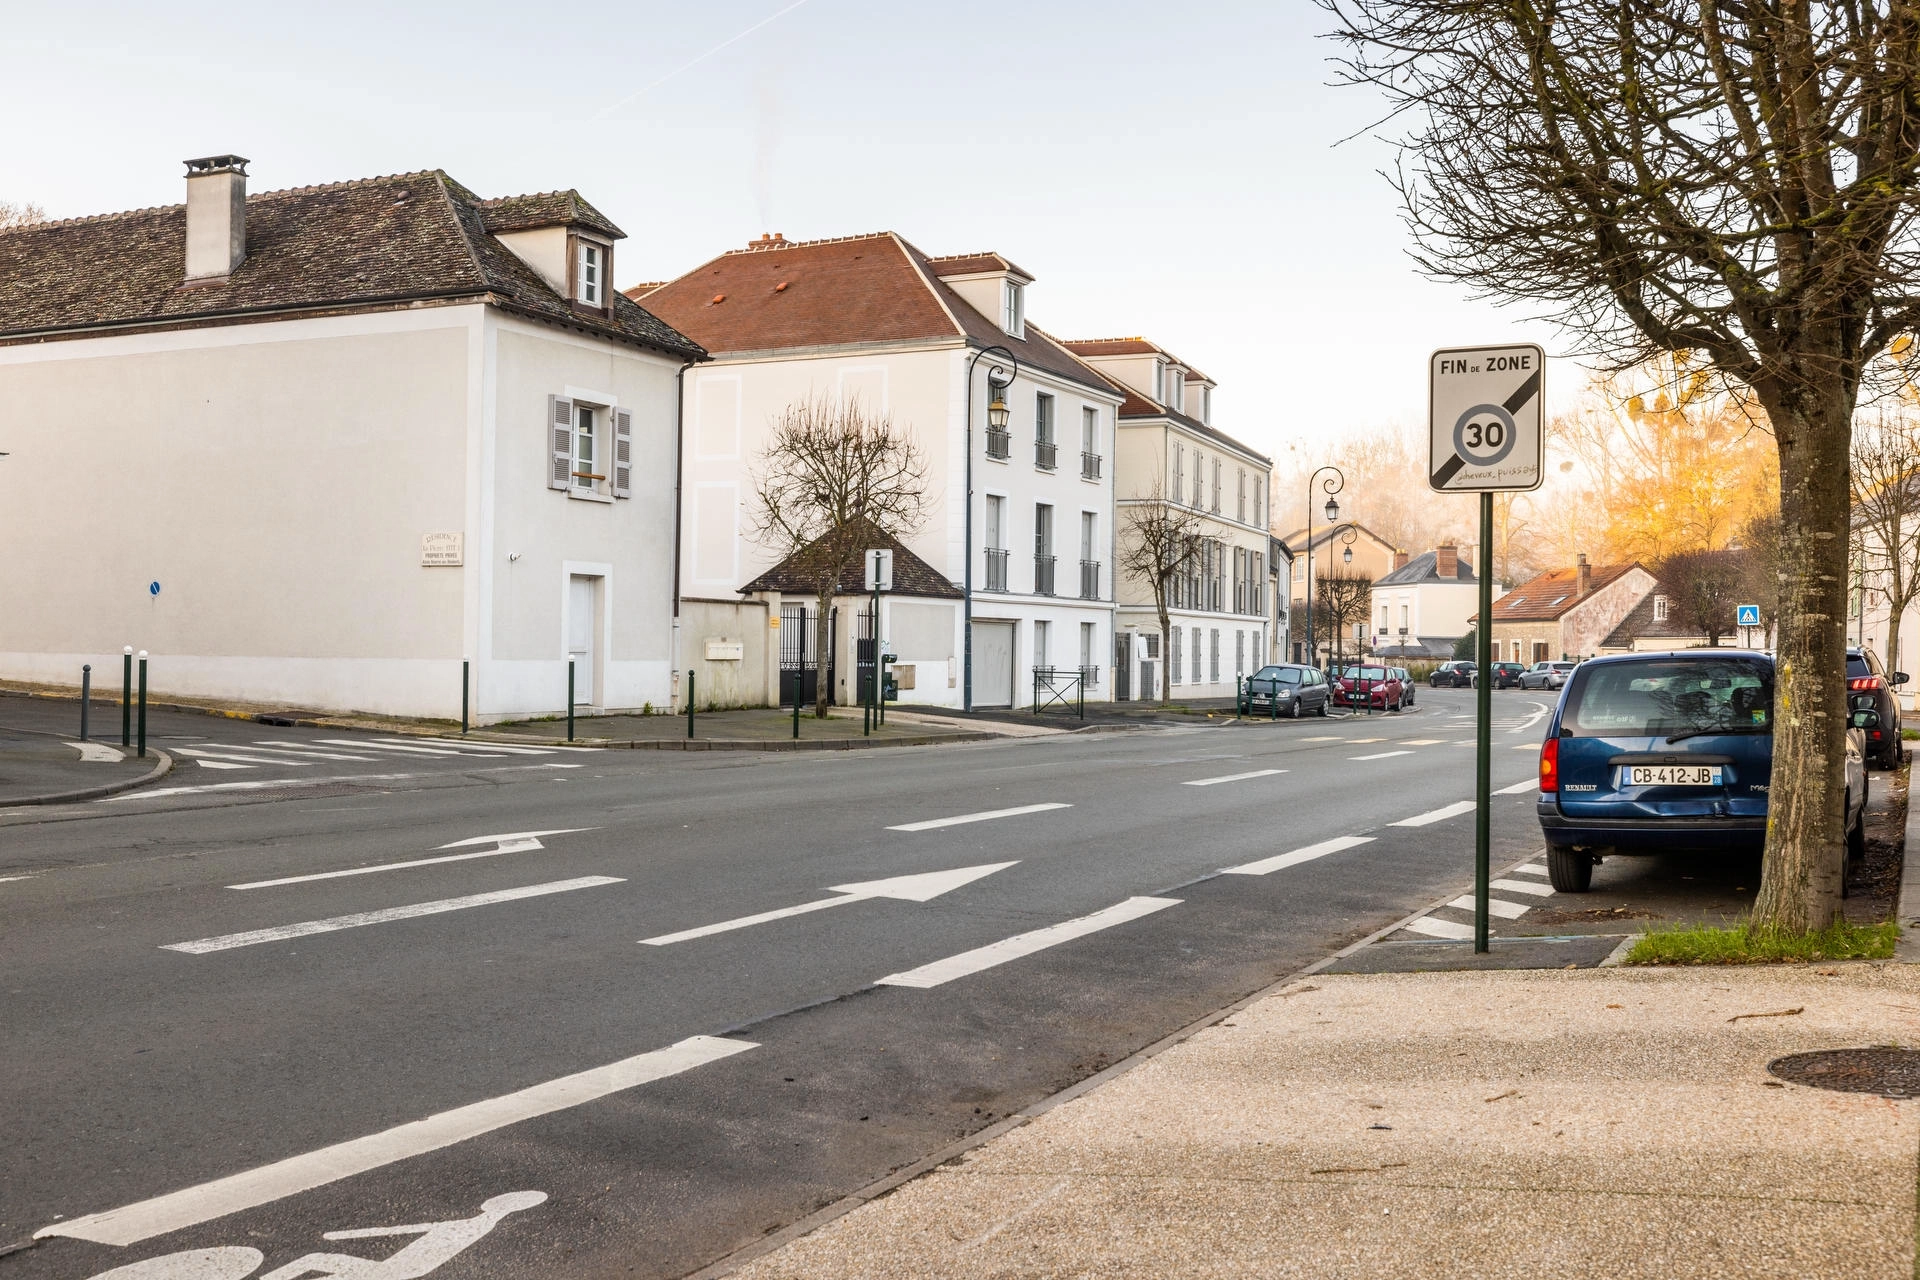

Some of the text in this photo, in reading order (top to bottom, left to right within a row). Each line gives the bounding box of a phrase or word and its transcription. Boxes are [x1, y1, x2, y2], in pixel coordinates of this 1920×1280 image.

[1441, 359, 1467, 374] FIN
[1486, 355, 1531, 372] ZONE
[1466, 422, 1504, 448] 30
[1633, 767, 1711, 784] CB-412-JB
